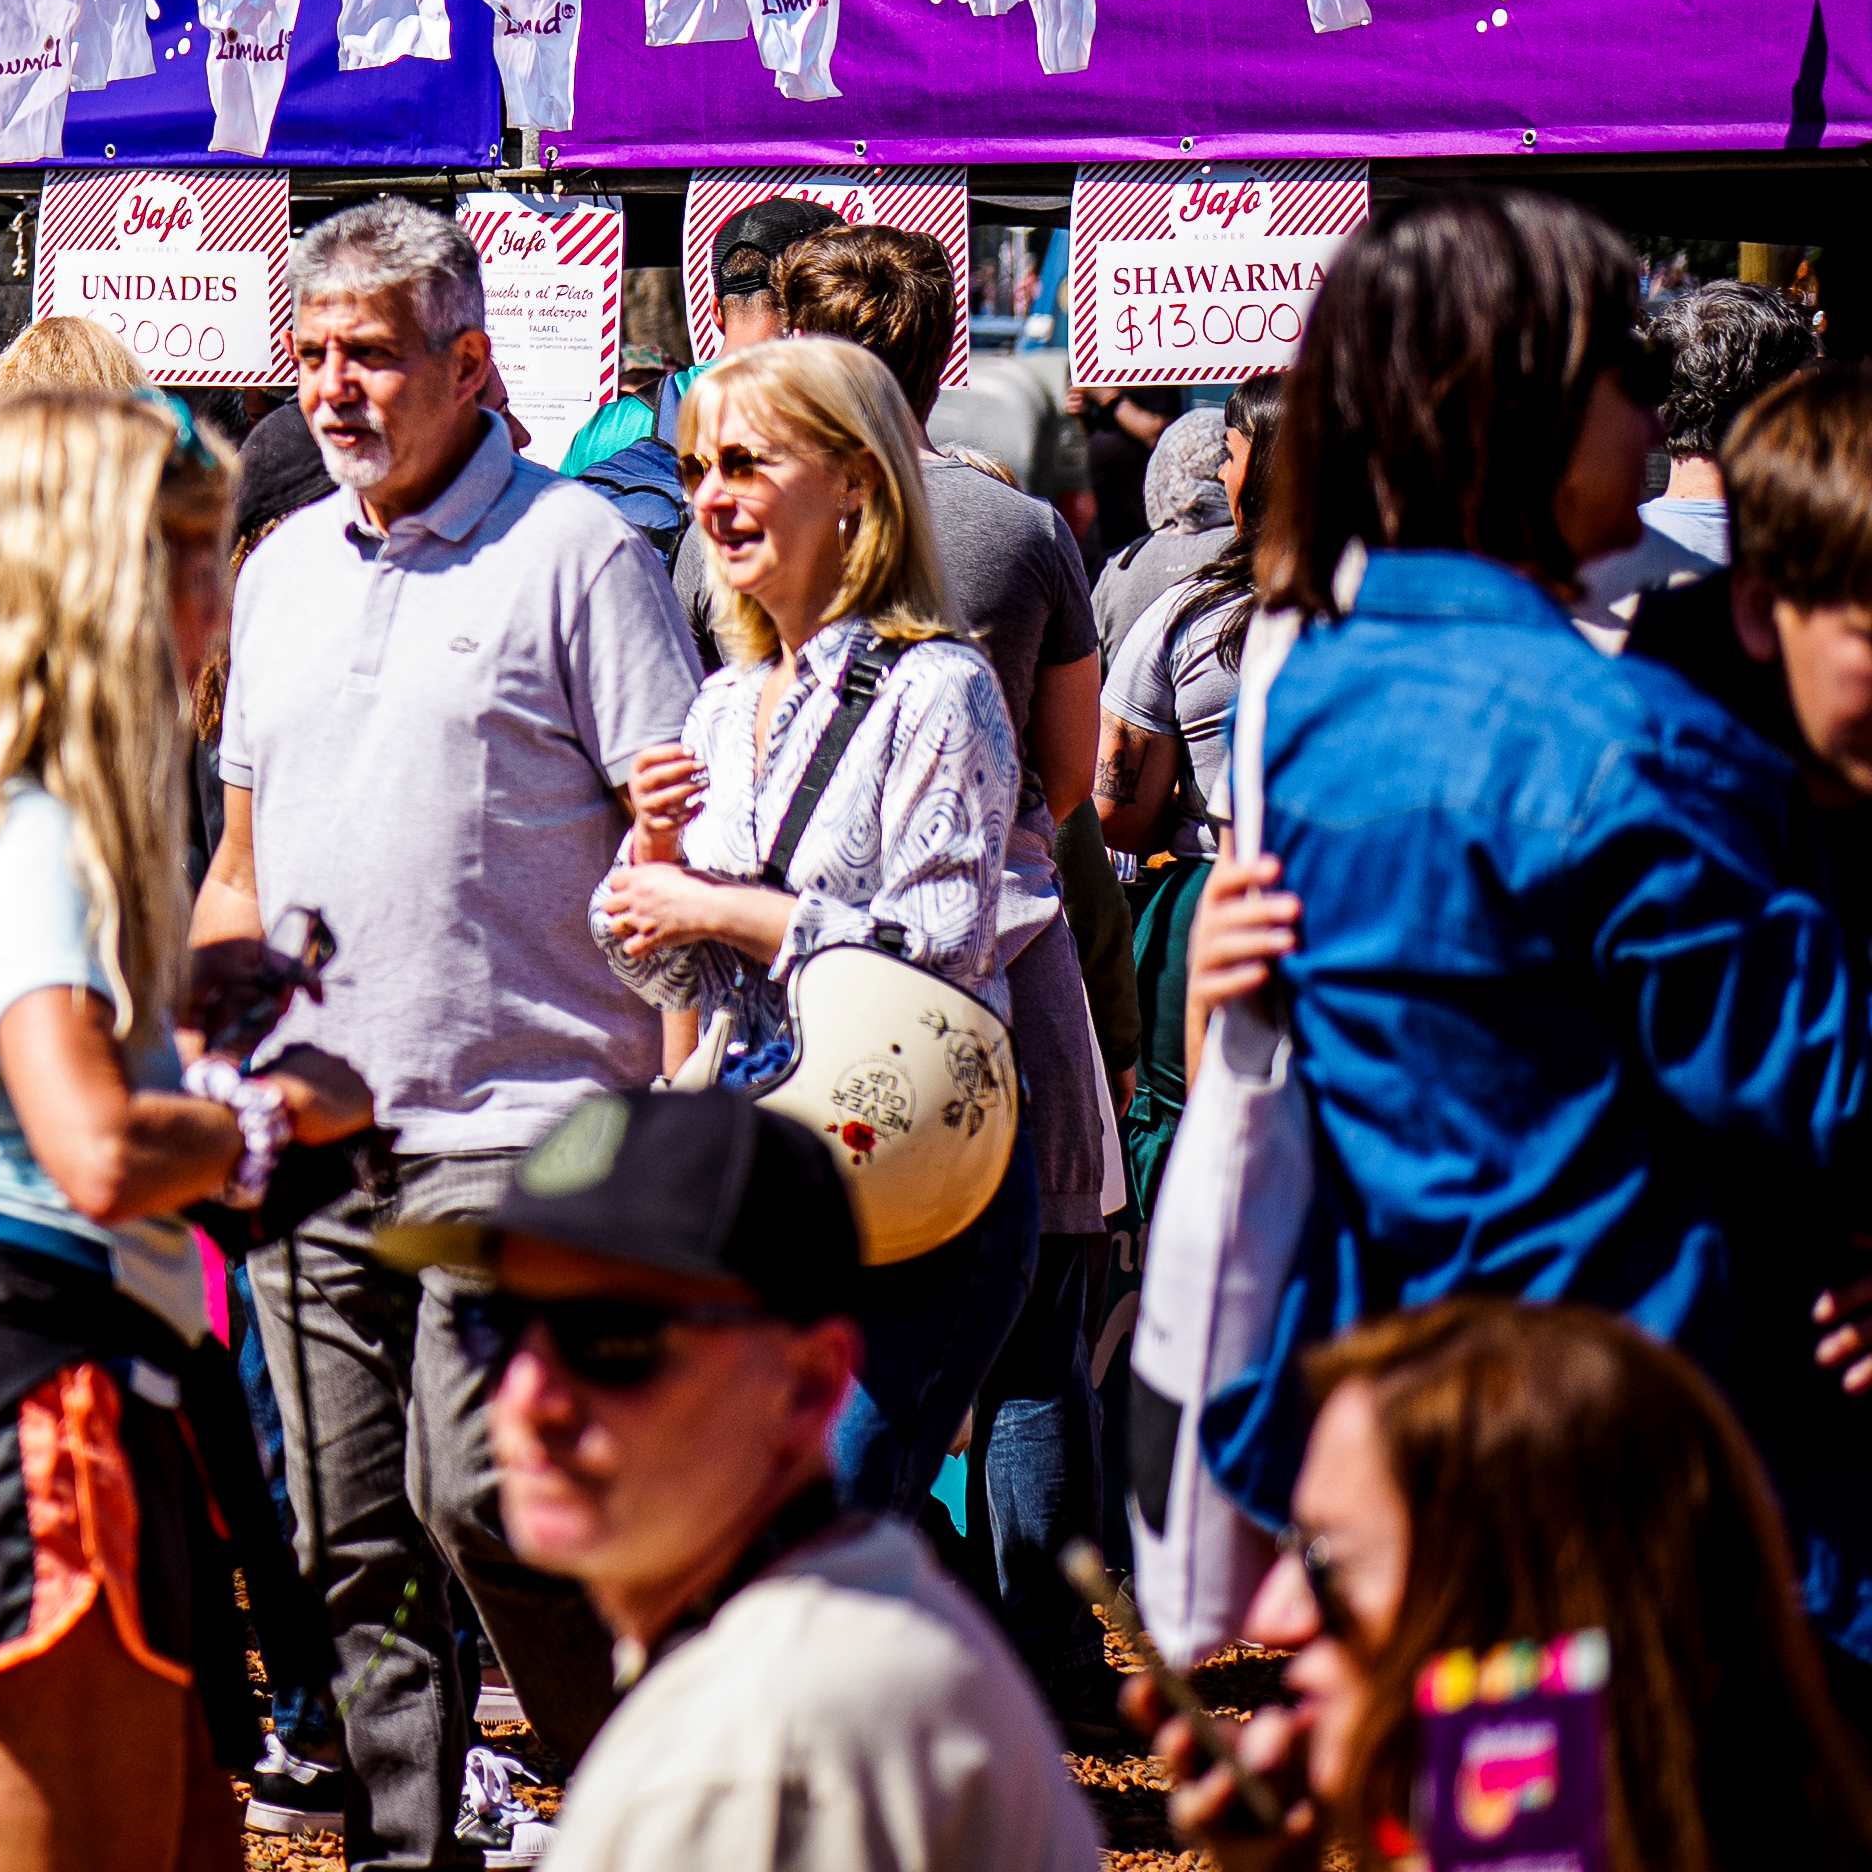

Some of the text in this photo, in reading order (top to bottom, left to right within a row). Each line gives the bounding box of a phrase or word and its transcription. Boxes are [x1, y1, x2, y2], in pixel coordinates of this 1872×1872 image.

[216, 27, 284, 62] Limud
[124, 194, 194, 243] Yafo
[1180, 177, 1262, 229] Yafo
[499, 229, 547, 260] Yafo
[1194, 232, 1246, 241] KOSHER
[82, 275, 238, 302] UNIDADES
[535, 286, 549, 299] al
[556, 284, 594, 301] Plato
[1113, 262, 1328, 295] SHAWARMA
[528, 325, 560, 334] FALAFEL
[538, 307, 588, 322] aderezos
[1114, 303, 1303, 356] $13.000
